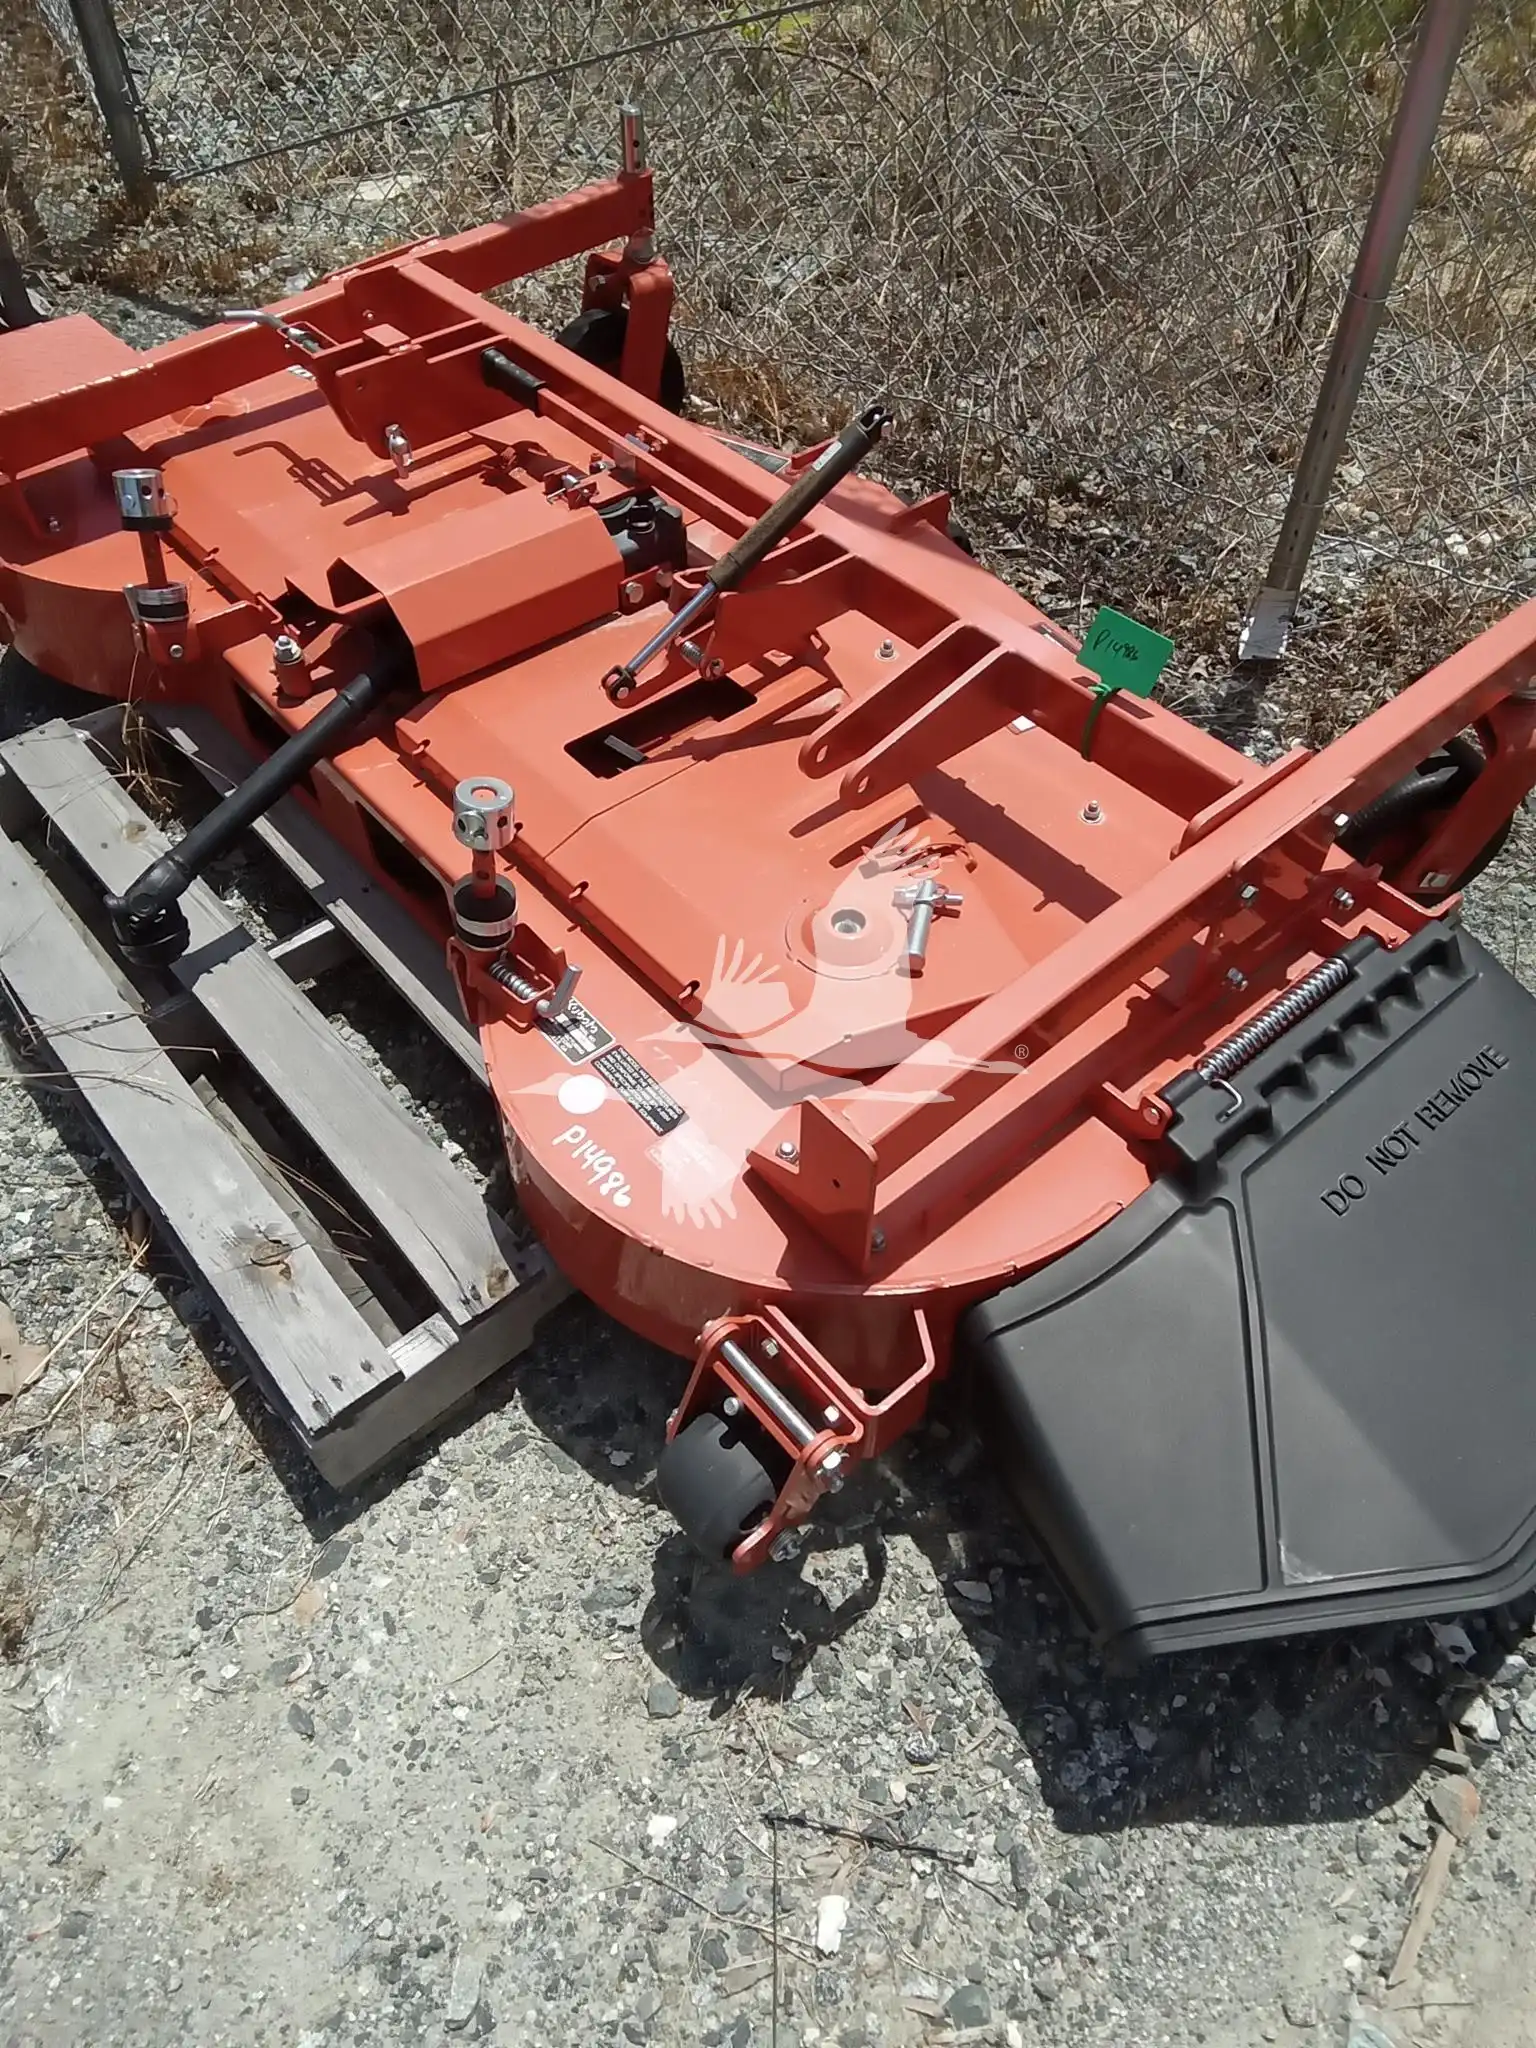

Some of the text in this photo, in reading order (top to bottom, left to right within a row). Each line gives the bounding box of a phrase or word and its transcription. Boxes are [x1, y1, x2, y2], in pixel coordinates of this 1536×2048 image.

[568, 999, 598, 1034] Kubota
[552, 1124, 632, 1208] P14986
[1320, 1044, 1510, 1217] DO NOT REMOVE
